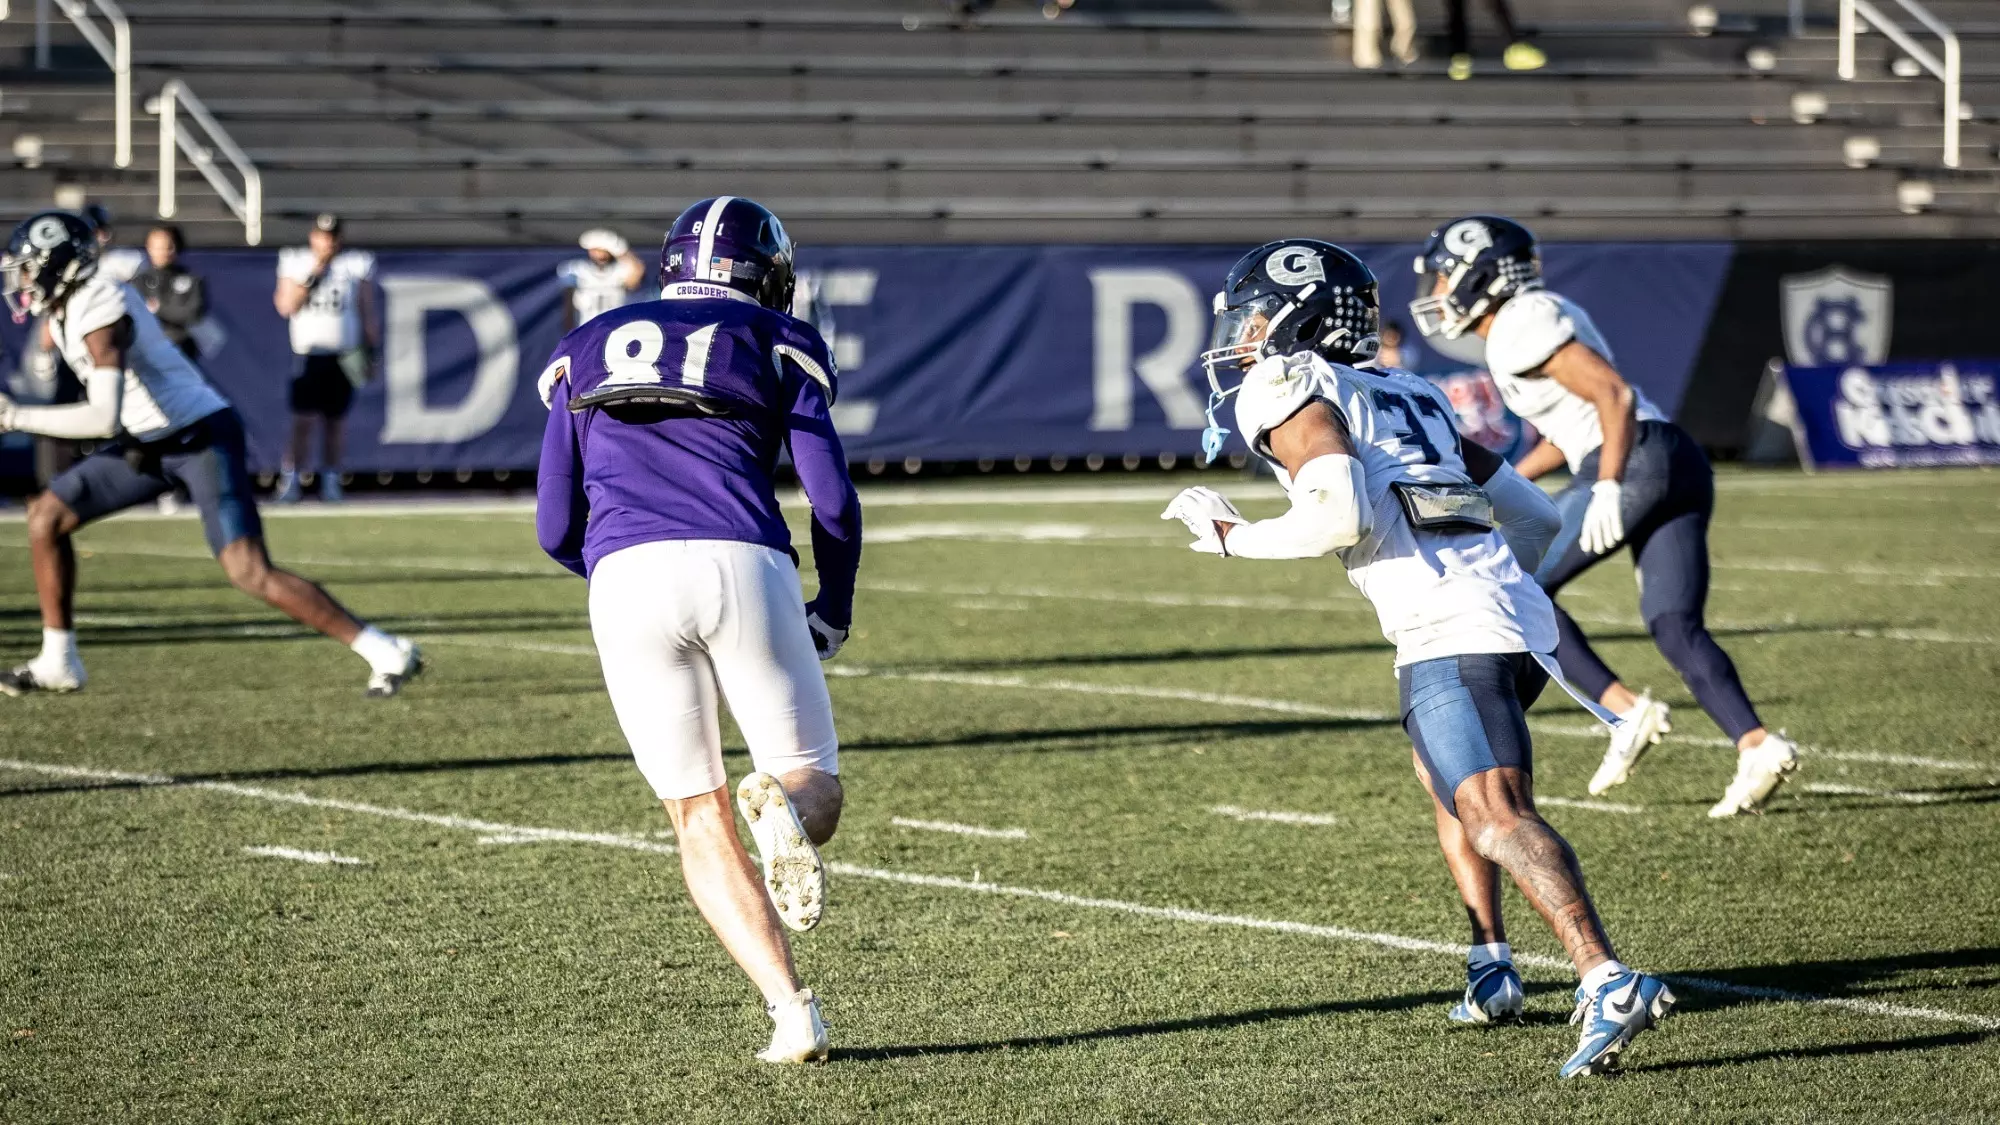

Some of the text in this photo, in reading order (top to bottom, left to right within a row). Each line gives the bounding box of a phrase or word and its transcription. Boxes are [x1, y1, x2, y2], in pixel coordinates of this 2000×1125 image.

[1444, 219, 1493, 256] G
[1265, 246, 1326, 286] G
[677, 285, 728, 299] CRUSADERS
[598, 320, 722, 387] 81
